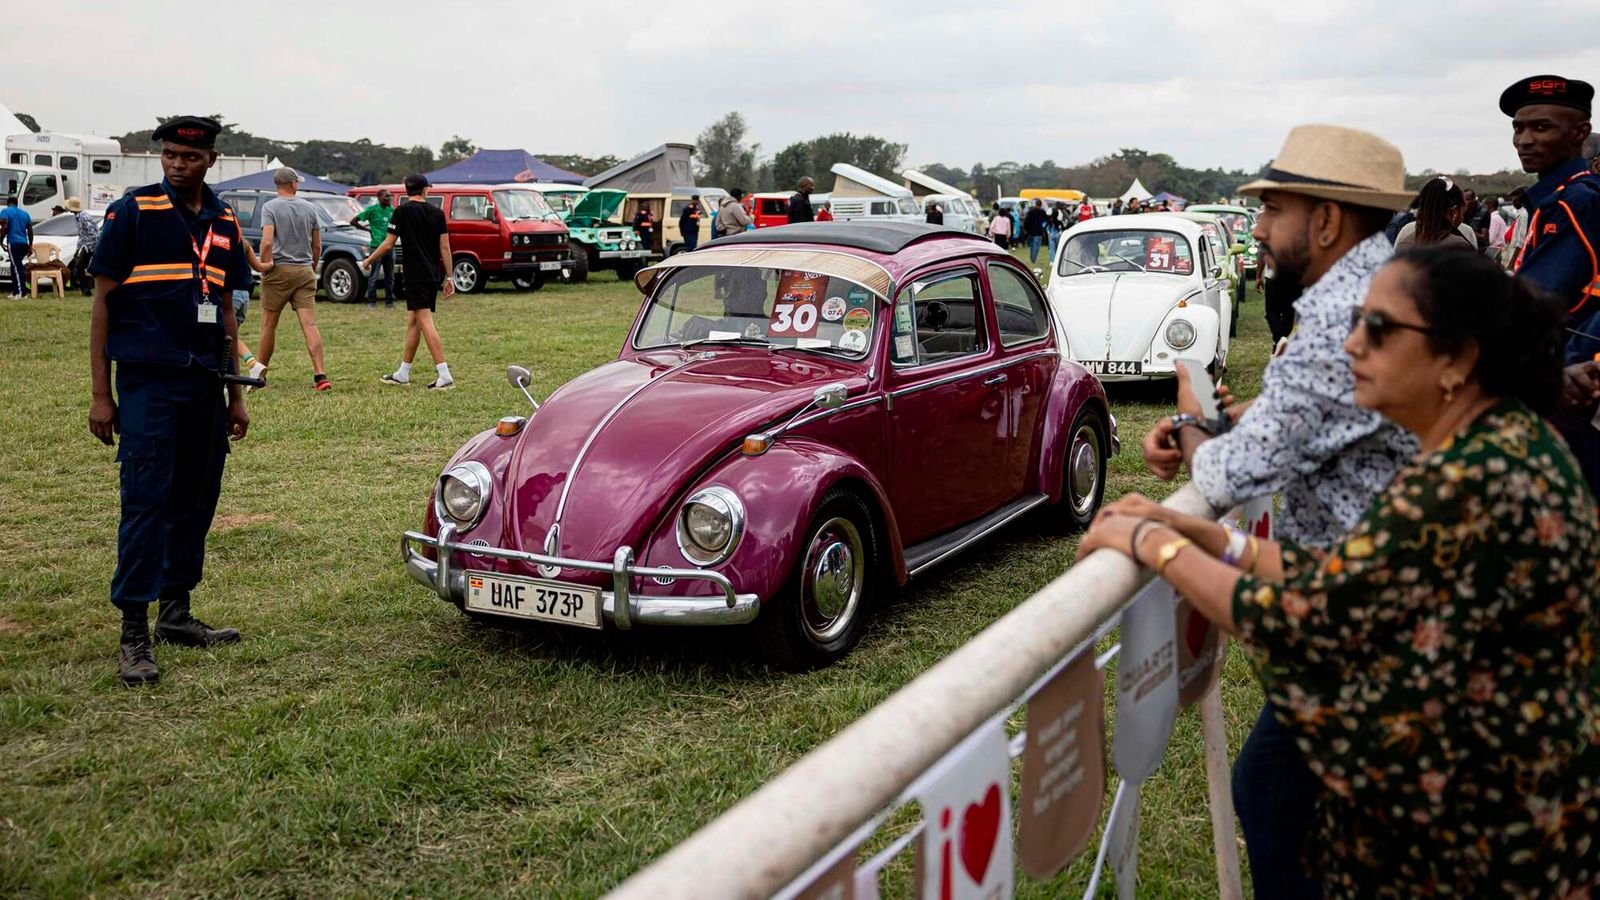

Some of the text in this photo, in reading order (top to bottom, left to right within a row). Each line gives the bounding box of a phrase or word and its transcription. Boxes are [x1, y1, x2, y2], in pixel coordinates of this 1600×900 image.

[1150, 253, 1170, 267] 31
[771, 304, 817, 332] 30
[492, 583, 583, 617] UAF 373P
